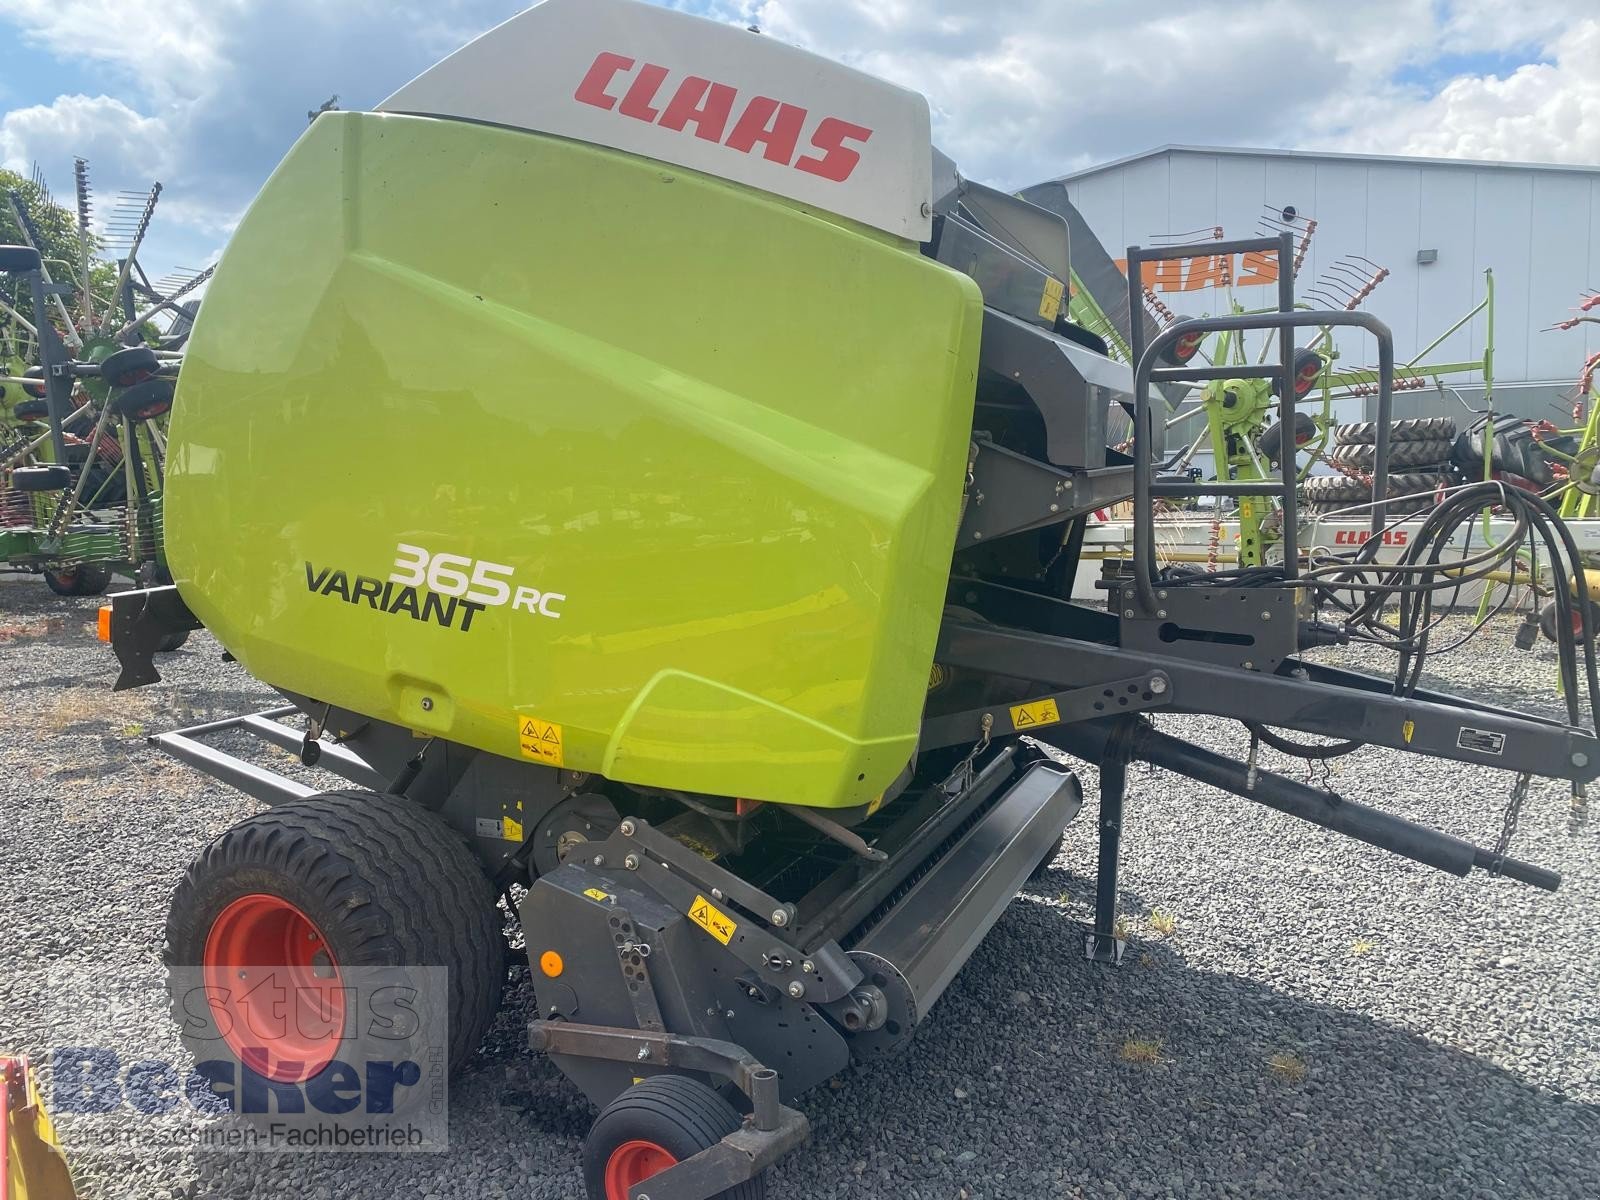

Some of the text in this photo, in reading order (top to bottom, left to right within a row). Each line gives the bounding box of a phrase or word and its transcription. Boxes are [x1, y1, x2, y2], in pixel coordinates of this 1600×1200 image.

[574, 51, 873, 183] CLAAS
[1112, 248, 1280, 293] AAS
[305, 560, 486, 632] VARIANT
[389, 542, 566, 619] 365 RC
